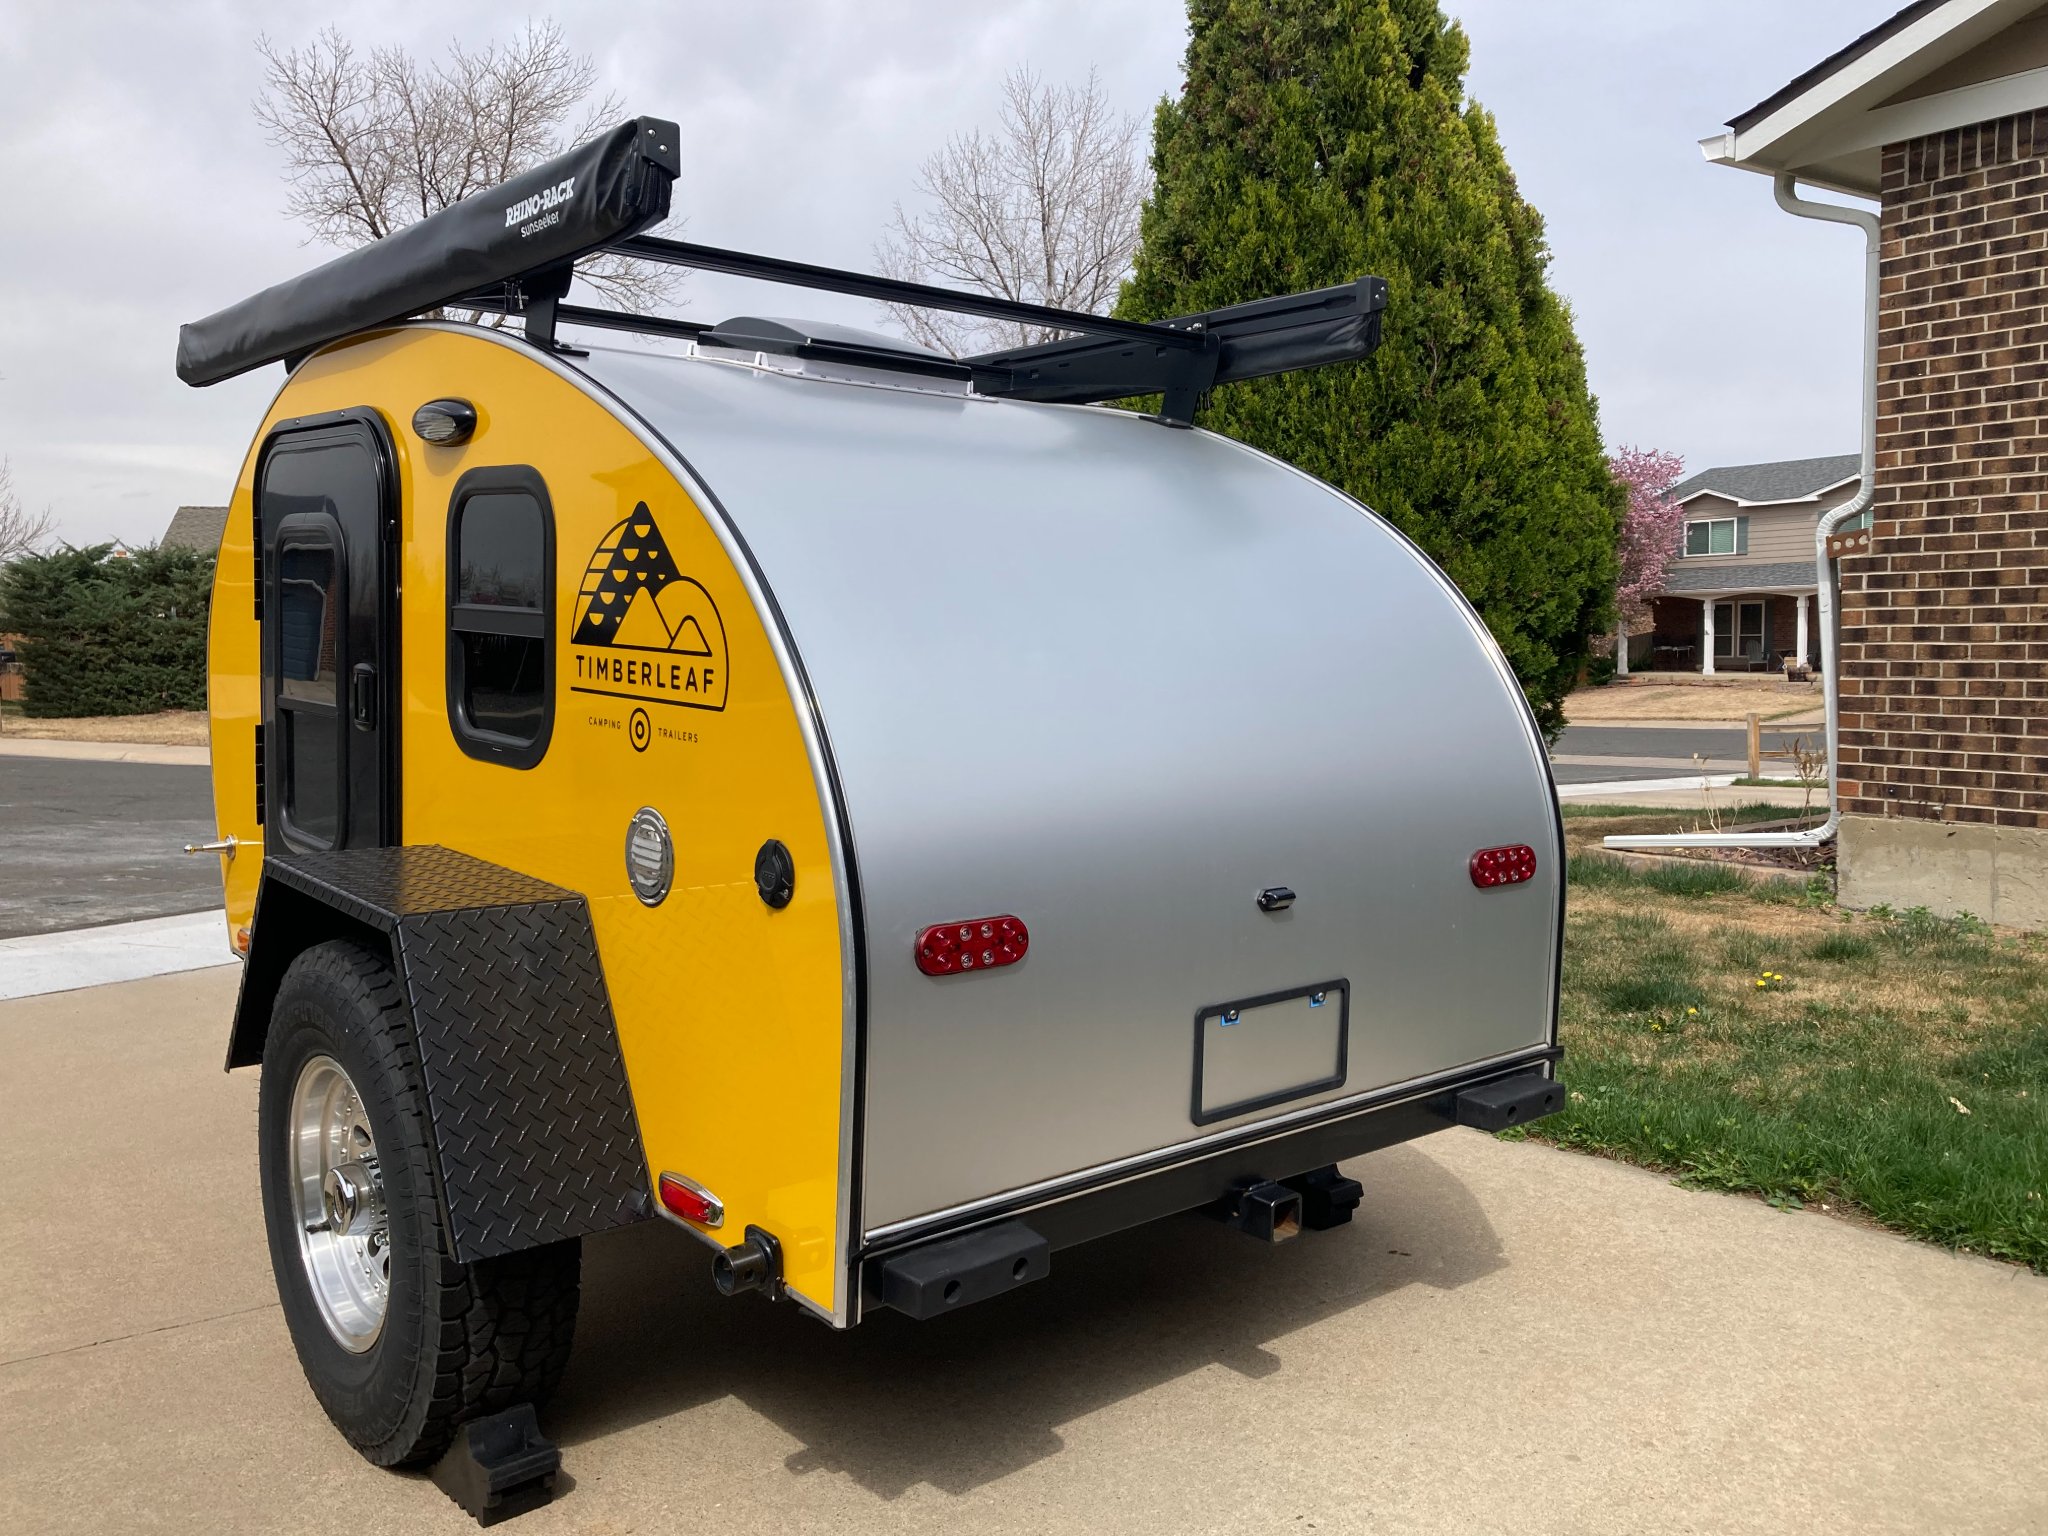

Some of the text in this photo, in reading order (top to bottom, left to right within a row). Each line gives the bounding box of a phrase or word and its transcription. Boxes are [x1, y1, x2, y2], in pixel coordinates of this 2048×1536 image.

[505, 177, 575, 228] RHINO-RACK
[520, 211, 559, 238] sunseeker
[575, 654, 714, 694] TIMBERLEAF
[588, 716, 699, 743] CAMPING TRAILERS
